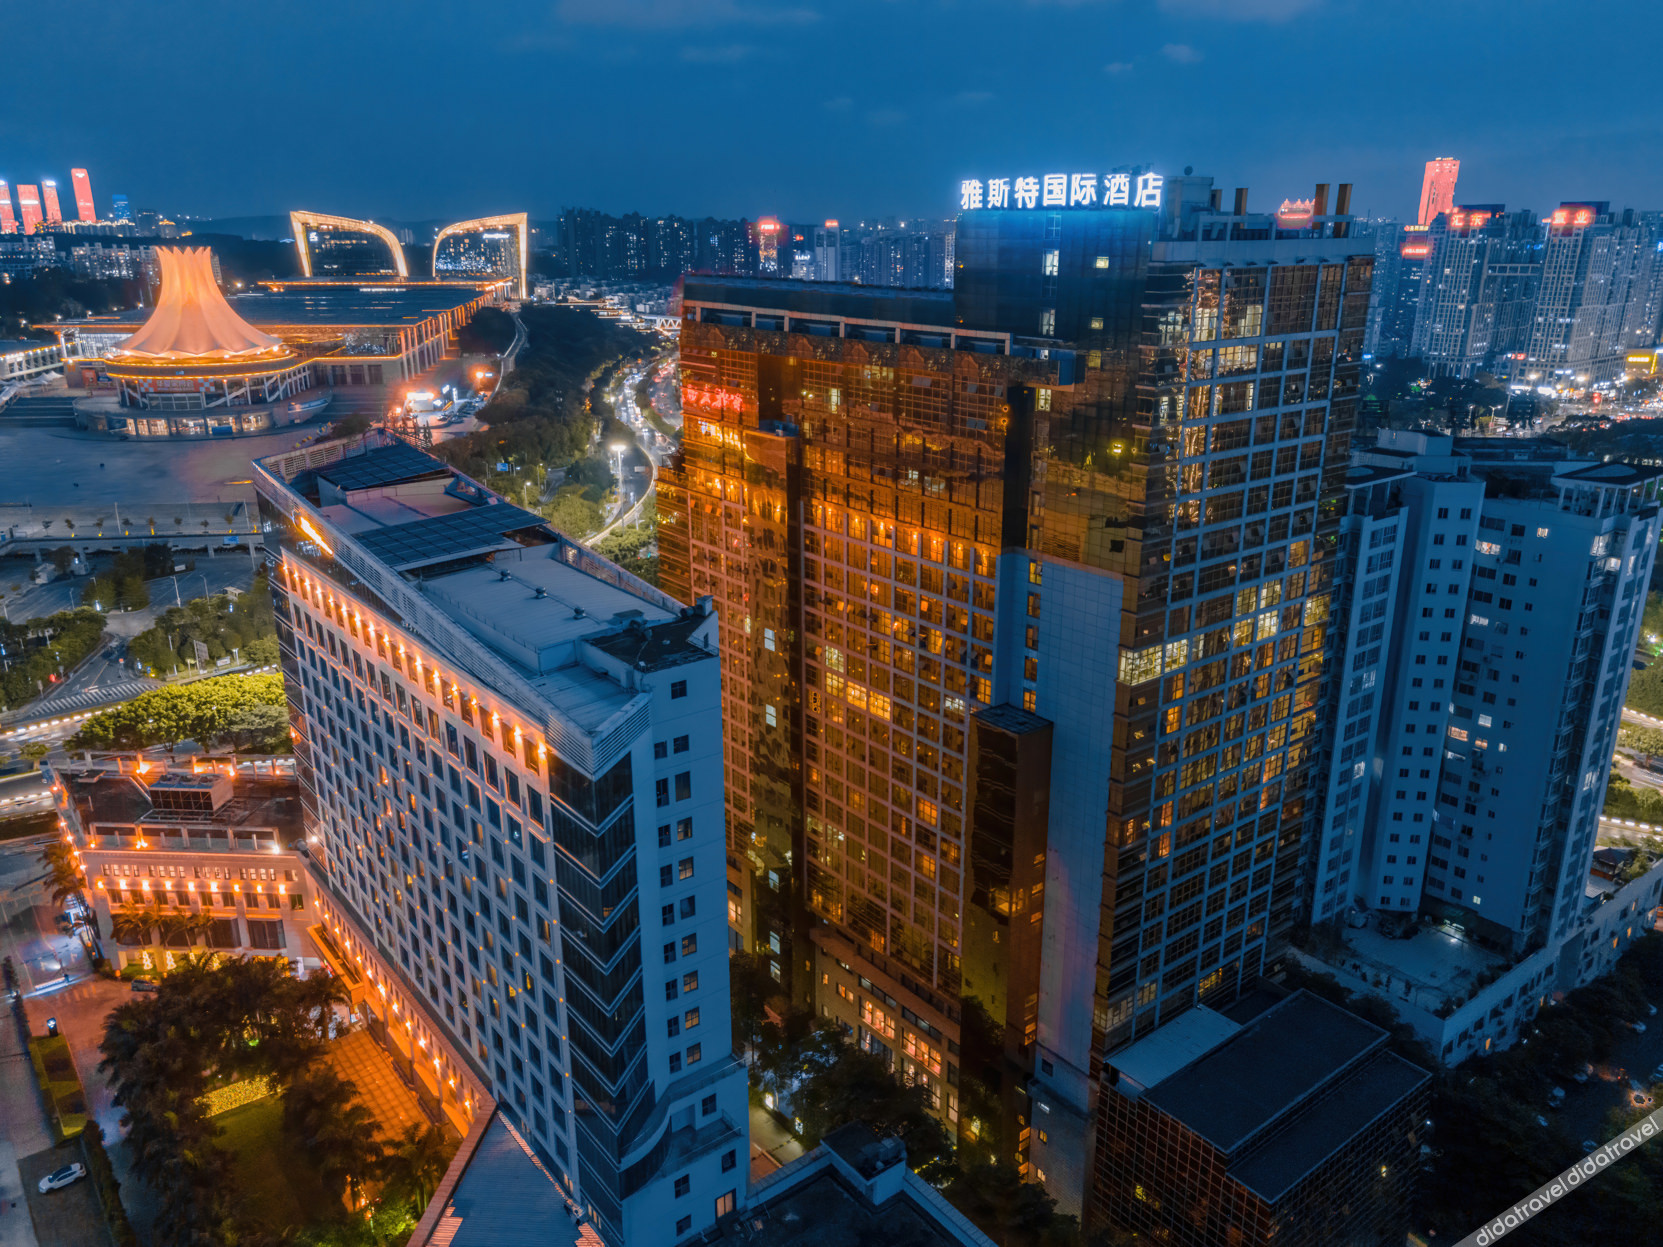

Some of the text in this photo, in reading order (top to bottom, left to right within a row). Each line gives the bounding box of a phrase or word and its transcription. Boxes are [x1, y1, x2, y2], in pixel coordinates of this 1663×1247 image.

[960, 172, 1164, 209] 雅斯特国际酒店
